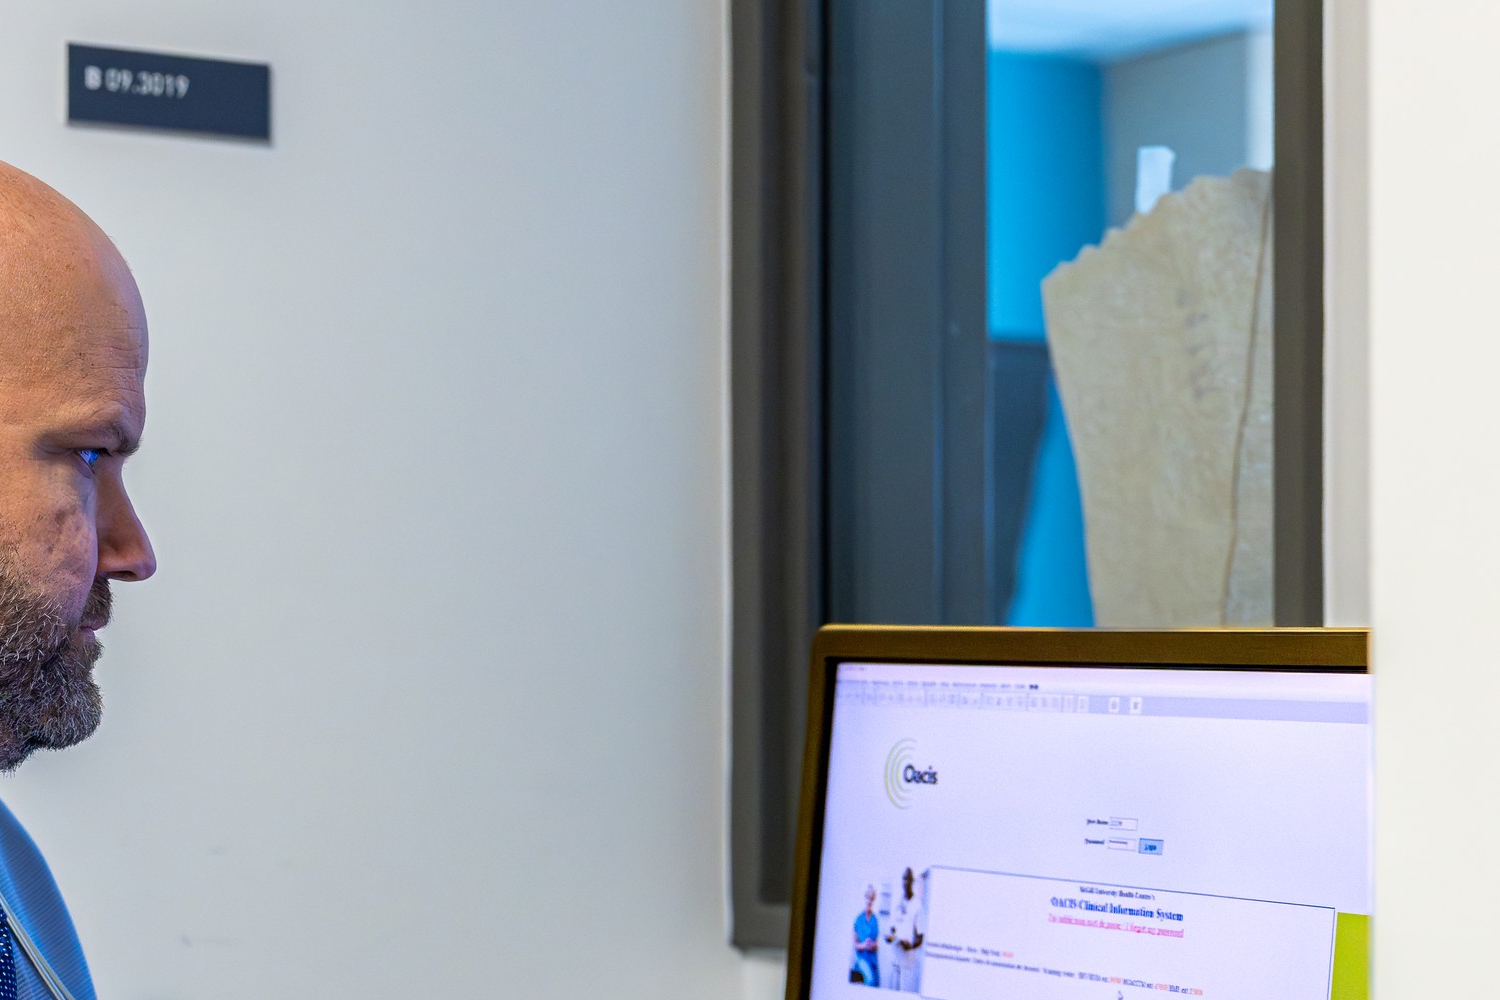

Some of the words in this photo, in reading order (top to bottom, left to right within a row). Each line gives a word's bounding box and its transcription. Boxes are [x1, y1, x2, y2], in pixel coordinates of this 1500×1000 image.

[1078, 899, 1108, 912] Clinical
[1109, 903, 1154, 918] Information
[1156, 908, 1183, 921] System
